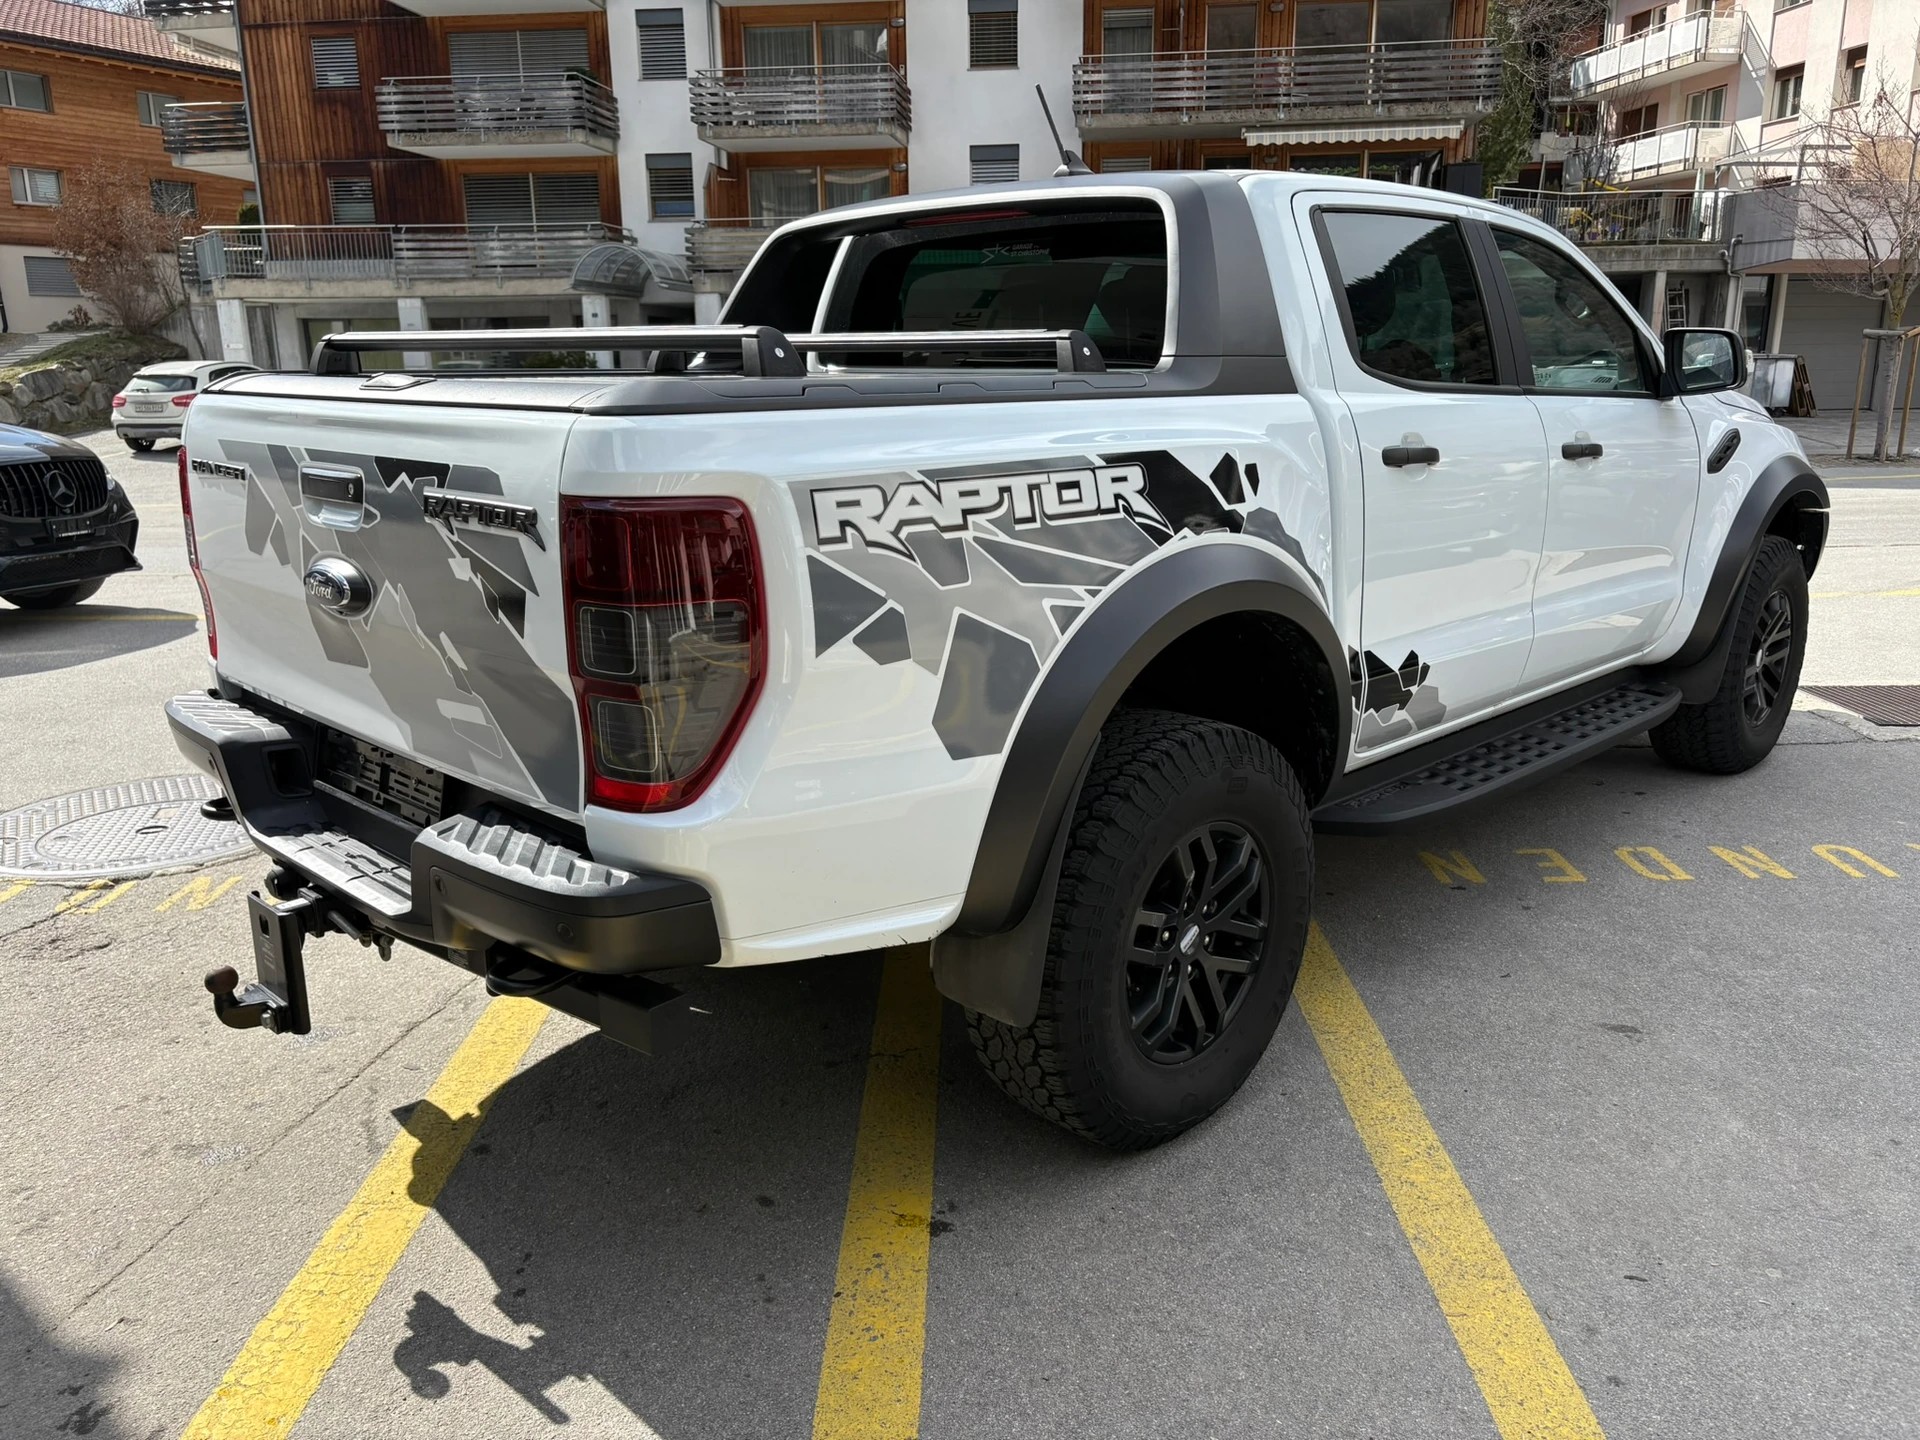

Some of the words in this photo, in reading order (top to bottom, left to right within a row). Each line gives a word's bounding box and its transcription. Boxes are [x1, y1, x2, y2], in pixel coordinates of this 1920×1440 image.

[191, 457, 247, 482] RANGER
[423, 488, 547, 552] RAPTOR
[809, 462, 1175, 565] RAPTOR
[309, 572, 333, 600] Ford
[1418, 843, 1920, 884] UNDEN
